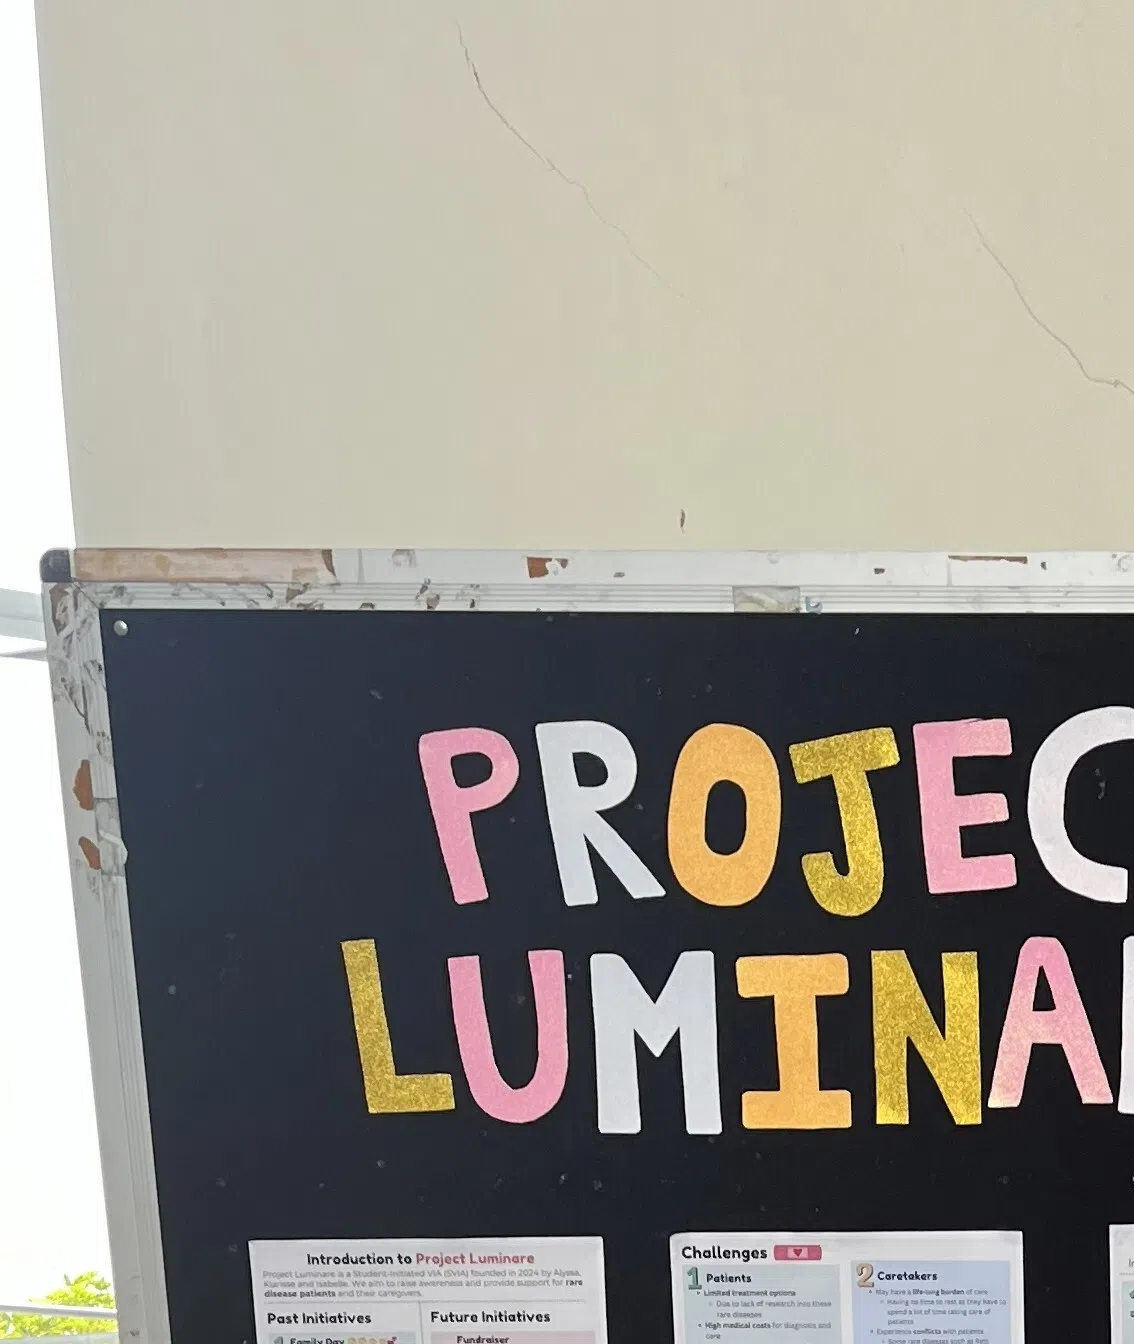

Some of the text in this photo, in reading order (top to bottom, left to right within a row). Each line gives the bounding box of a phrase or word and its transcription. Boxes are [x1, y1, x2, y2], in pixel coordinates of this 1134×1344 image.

[307, 1252, 535, 1267] Introduction to Project Luminare
[682, 1246, 767, 1262] Challenges
[687, 1267, 702, 1290] 1
[706, 1274, 752, 1283] Patients
[856, 1263, 874, 1287] 2
[877, 1272, 937, 1281] Caretakers
[300, 1290, 336, 1298] patients
[267, 1312, 371, 1324] Past Initiatives
[431, 1311, 550, 1322] Future Initiatives
[457, 1336, 509, 1344] Fundraiser
